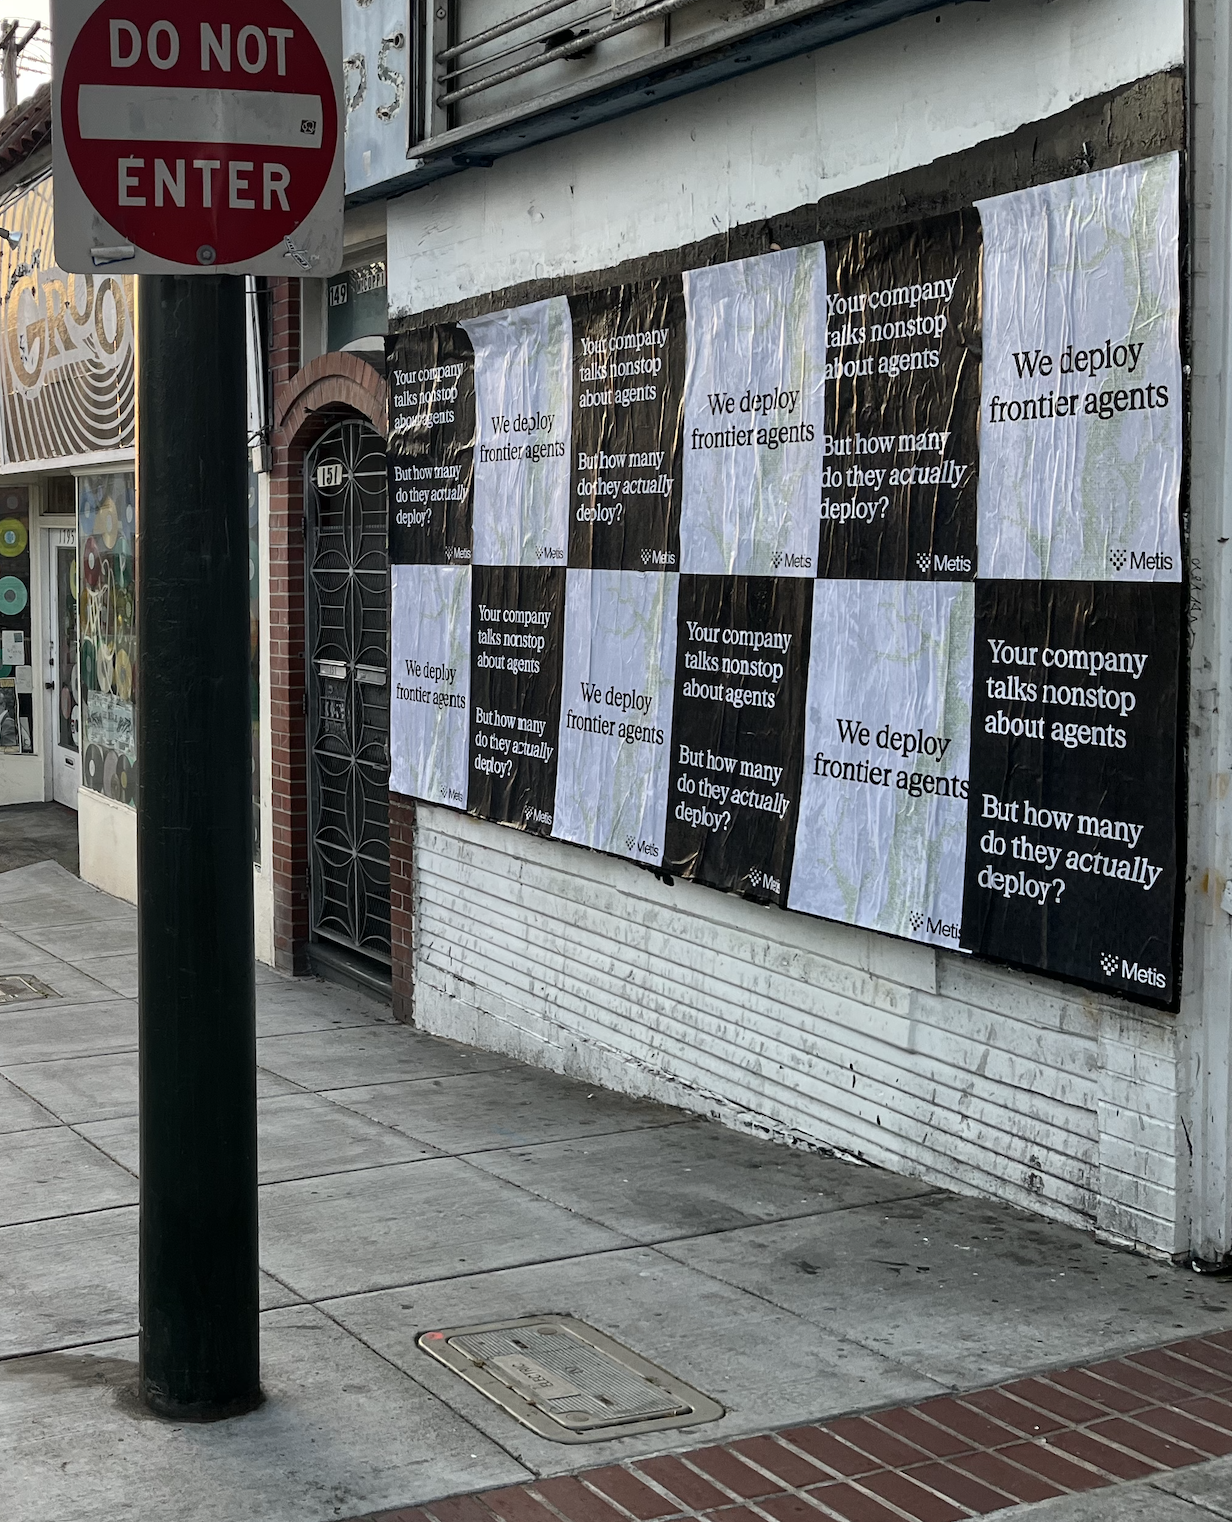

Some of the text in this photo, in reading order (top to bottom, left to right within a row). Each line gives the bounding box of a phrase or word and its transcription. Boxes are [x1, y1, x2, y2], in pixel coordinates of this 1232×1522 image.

[109, 18, 294, 76] DO NOT
[117, 157, 291, 211] ENTER
[330, 285, 346, 305] 149
[826, 275, 957, 317] Your company
[870, 311, 947, 342] nonstop
[581, 327, 669, 356] Your company
[580, 357, 661, 382] talks nonstop
[825, 347, 939, 380] about agents
[1013, 340, 1144, 378] We deploy
[393, 363, 463, 386] Your company
[394, 386, 458, 407] talks nonstop
[579, 387, 656, 408] about agents
[707, 387, 800, 416] We deploy
[989, 382, 1169, 423] frontier agents
[492, 412, 555, 434] We deploy
[691, 423, 815, 450] frontier agents
[480, 442, 565, 463] frontier agents
[823, 428, 951, 457] But how many
[395, 464, 462, 481] But how many
[578, 450, 664, 471] But how many
[323, 466, 337, 485] 151
[577, 475, 673, 498] do they actually
[822, 462, 967, 490] do they actually
[396, 485, 468, 505] do they actually
[821, 495, 888, 523] deploy?
[396, 508, 432, 526] deploy?
[577, 503, 622, 525] deploy?
[454, 547, 471, 559] Metis
[544, 547, 563, 559] Metis
[651, 550, 675, 564] Metis
[785, 553, 812, 569] Metis
[934, 554, 971, 573] Metis
[1130, 550, 1172, 570] Metis
[478, 605, 551, 629] Your company
[478, 629, 545, 653] talks nonstop
[686, 621, 792, 654] Your company
[405, 660, 457, 686] We deploy
[477, 654, 540, 675] about agents
[685, 651, 784, 682] talks nonstop
[988, 638, 1148, 680] Your company
[396, 685, 466, 710] frontier agents
[580, 681, 652, 715] We deploy
[683, 679, 776, 709] about agents
[986, 676, 1136, 717] talks nonstop
[476, 707, 546, 738] But how many
[567, 709, 664, 745] frontier agents
[984, 712, 1127, 749] about agents
[475, 732, 554, 764] do they actually
[837, 718, 951, 762] We deploy
[474, 755, 512, 778] deploy?
[679, 745, 783, 786] But how many
[813, 753, 970, 799] frontier agents
[677, 773, 790, 818] do they actually
[533, 810, 552, 826] Metis
[675, 802, 730, 832] deploy?
[982, 793, 1143, 849] But how many
[980, 831, 1163, 890] do they actually
[978, 864, 1065, 905] deploy?
[1121, 959, 1166, 988] Metis
